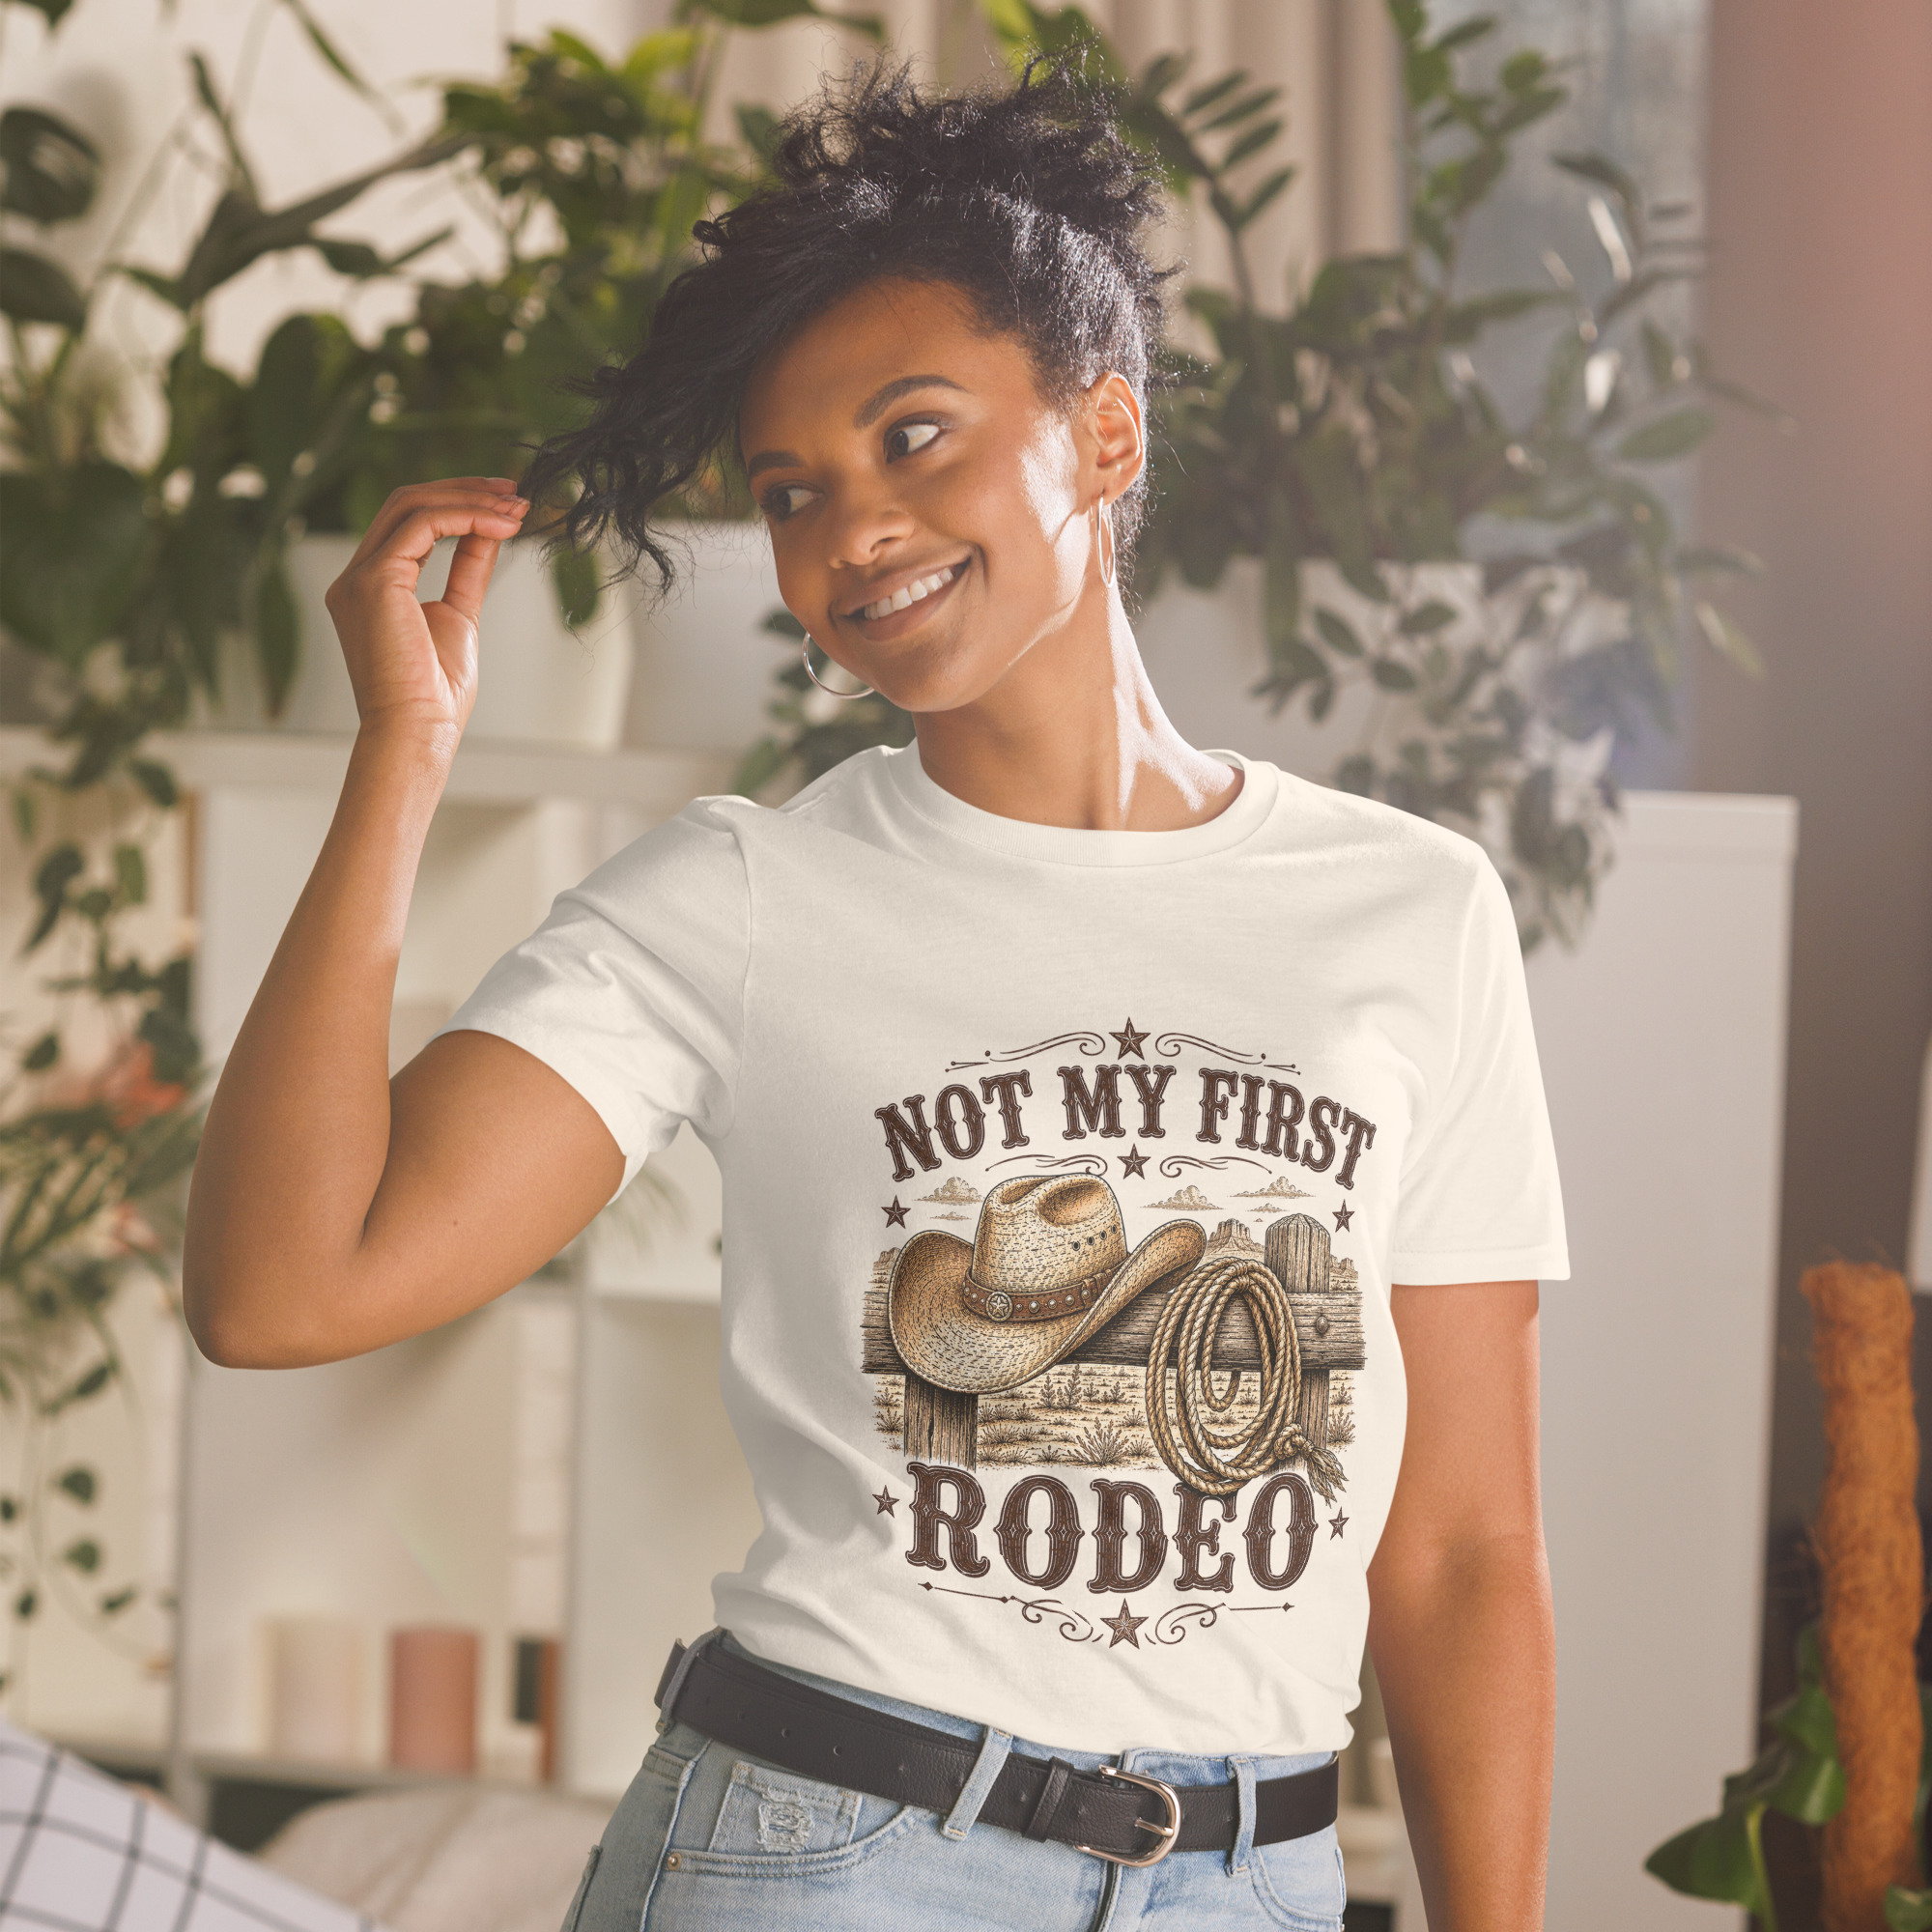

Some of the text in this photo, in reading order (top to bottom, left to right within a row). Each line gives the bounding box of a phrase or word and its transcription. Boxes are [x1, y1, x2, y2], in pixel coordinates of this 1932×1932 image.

[873, 1064, 1378, 1191] NOT MY FIRST
[904, 1461, 1320, 1595] RODEO
